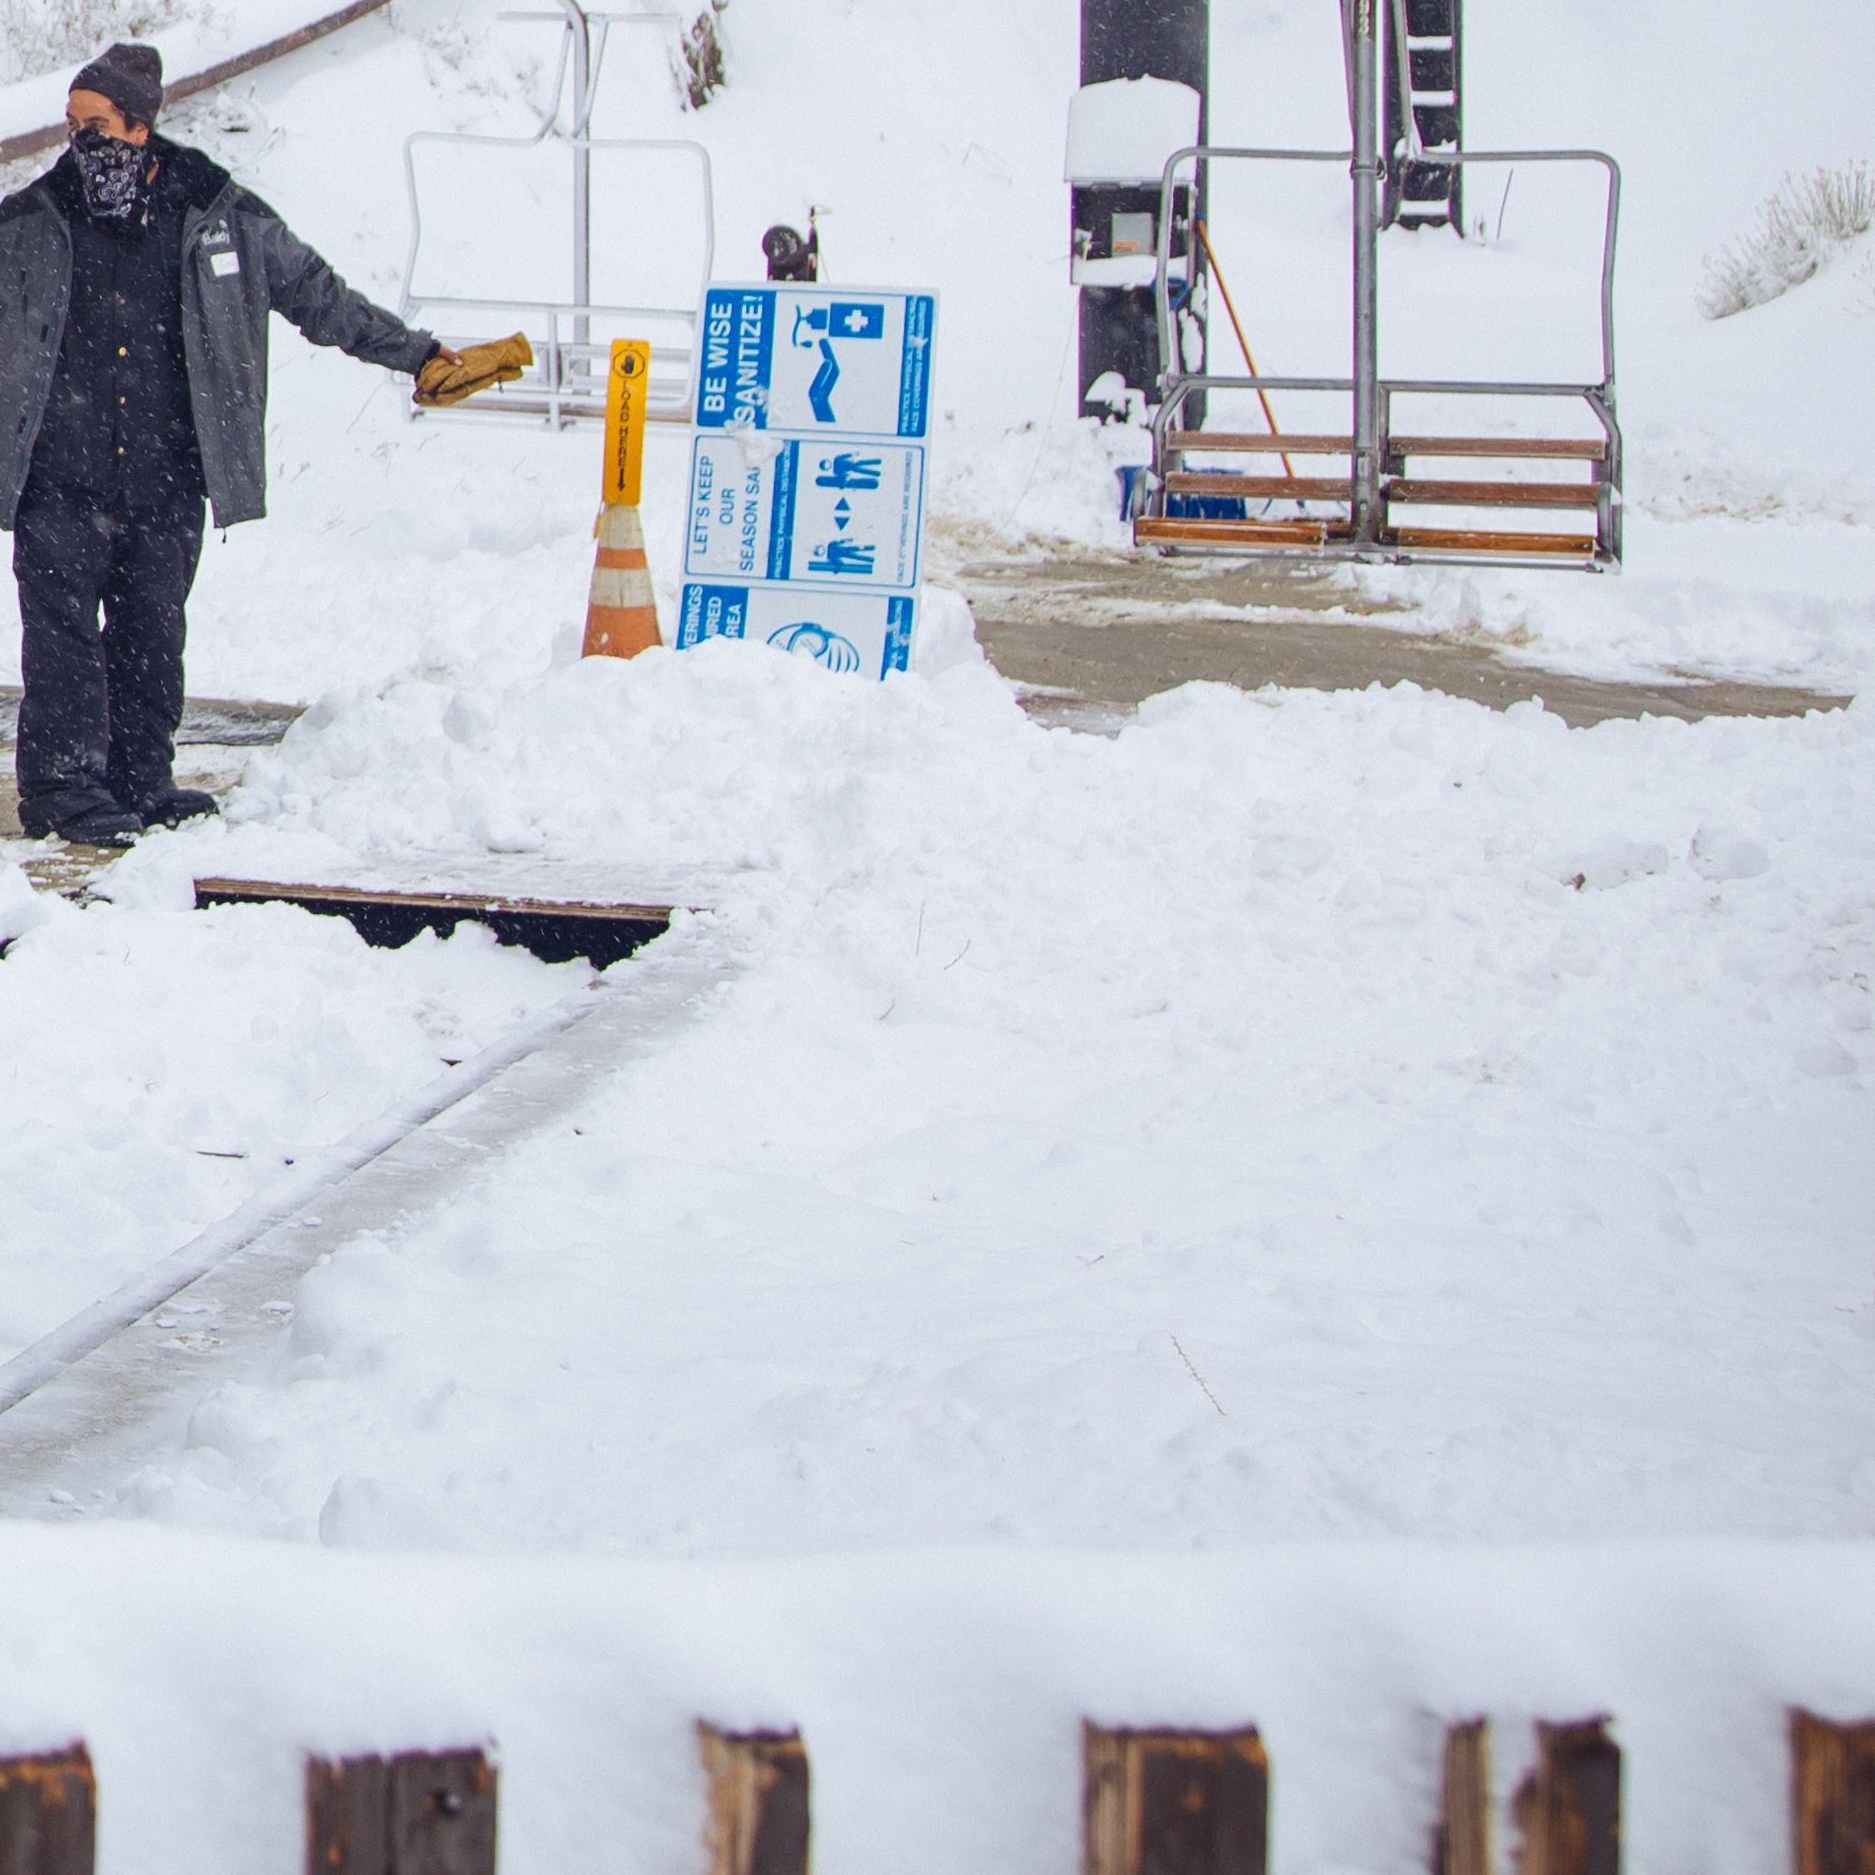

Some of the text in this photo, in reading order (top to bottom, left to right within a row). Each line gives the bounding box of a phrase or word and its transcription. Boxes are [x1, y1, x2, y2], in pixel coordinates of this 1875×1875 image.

[704, 303, 733, 413] BE WISE
[734, 295, 763, 423] SANITIZE!
[694, 456, 714, 555] LET'S KEEP
[719, 488, 736, 525] OUR
[739, 500, 759, 572] SEASON
[726, 604, 742, 637] REA
